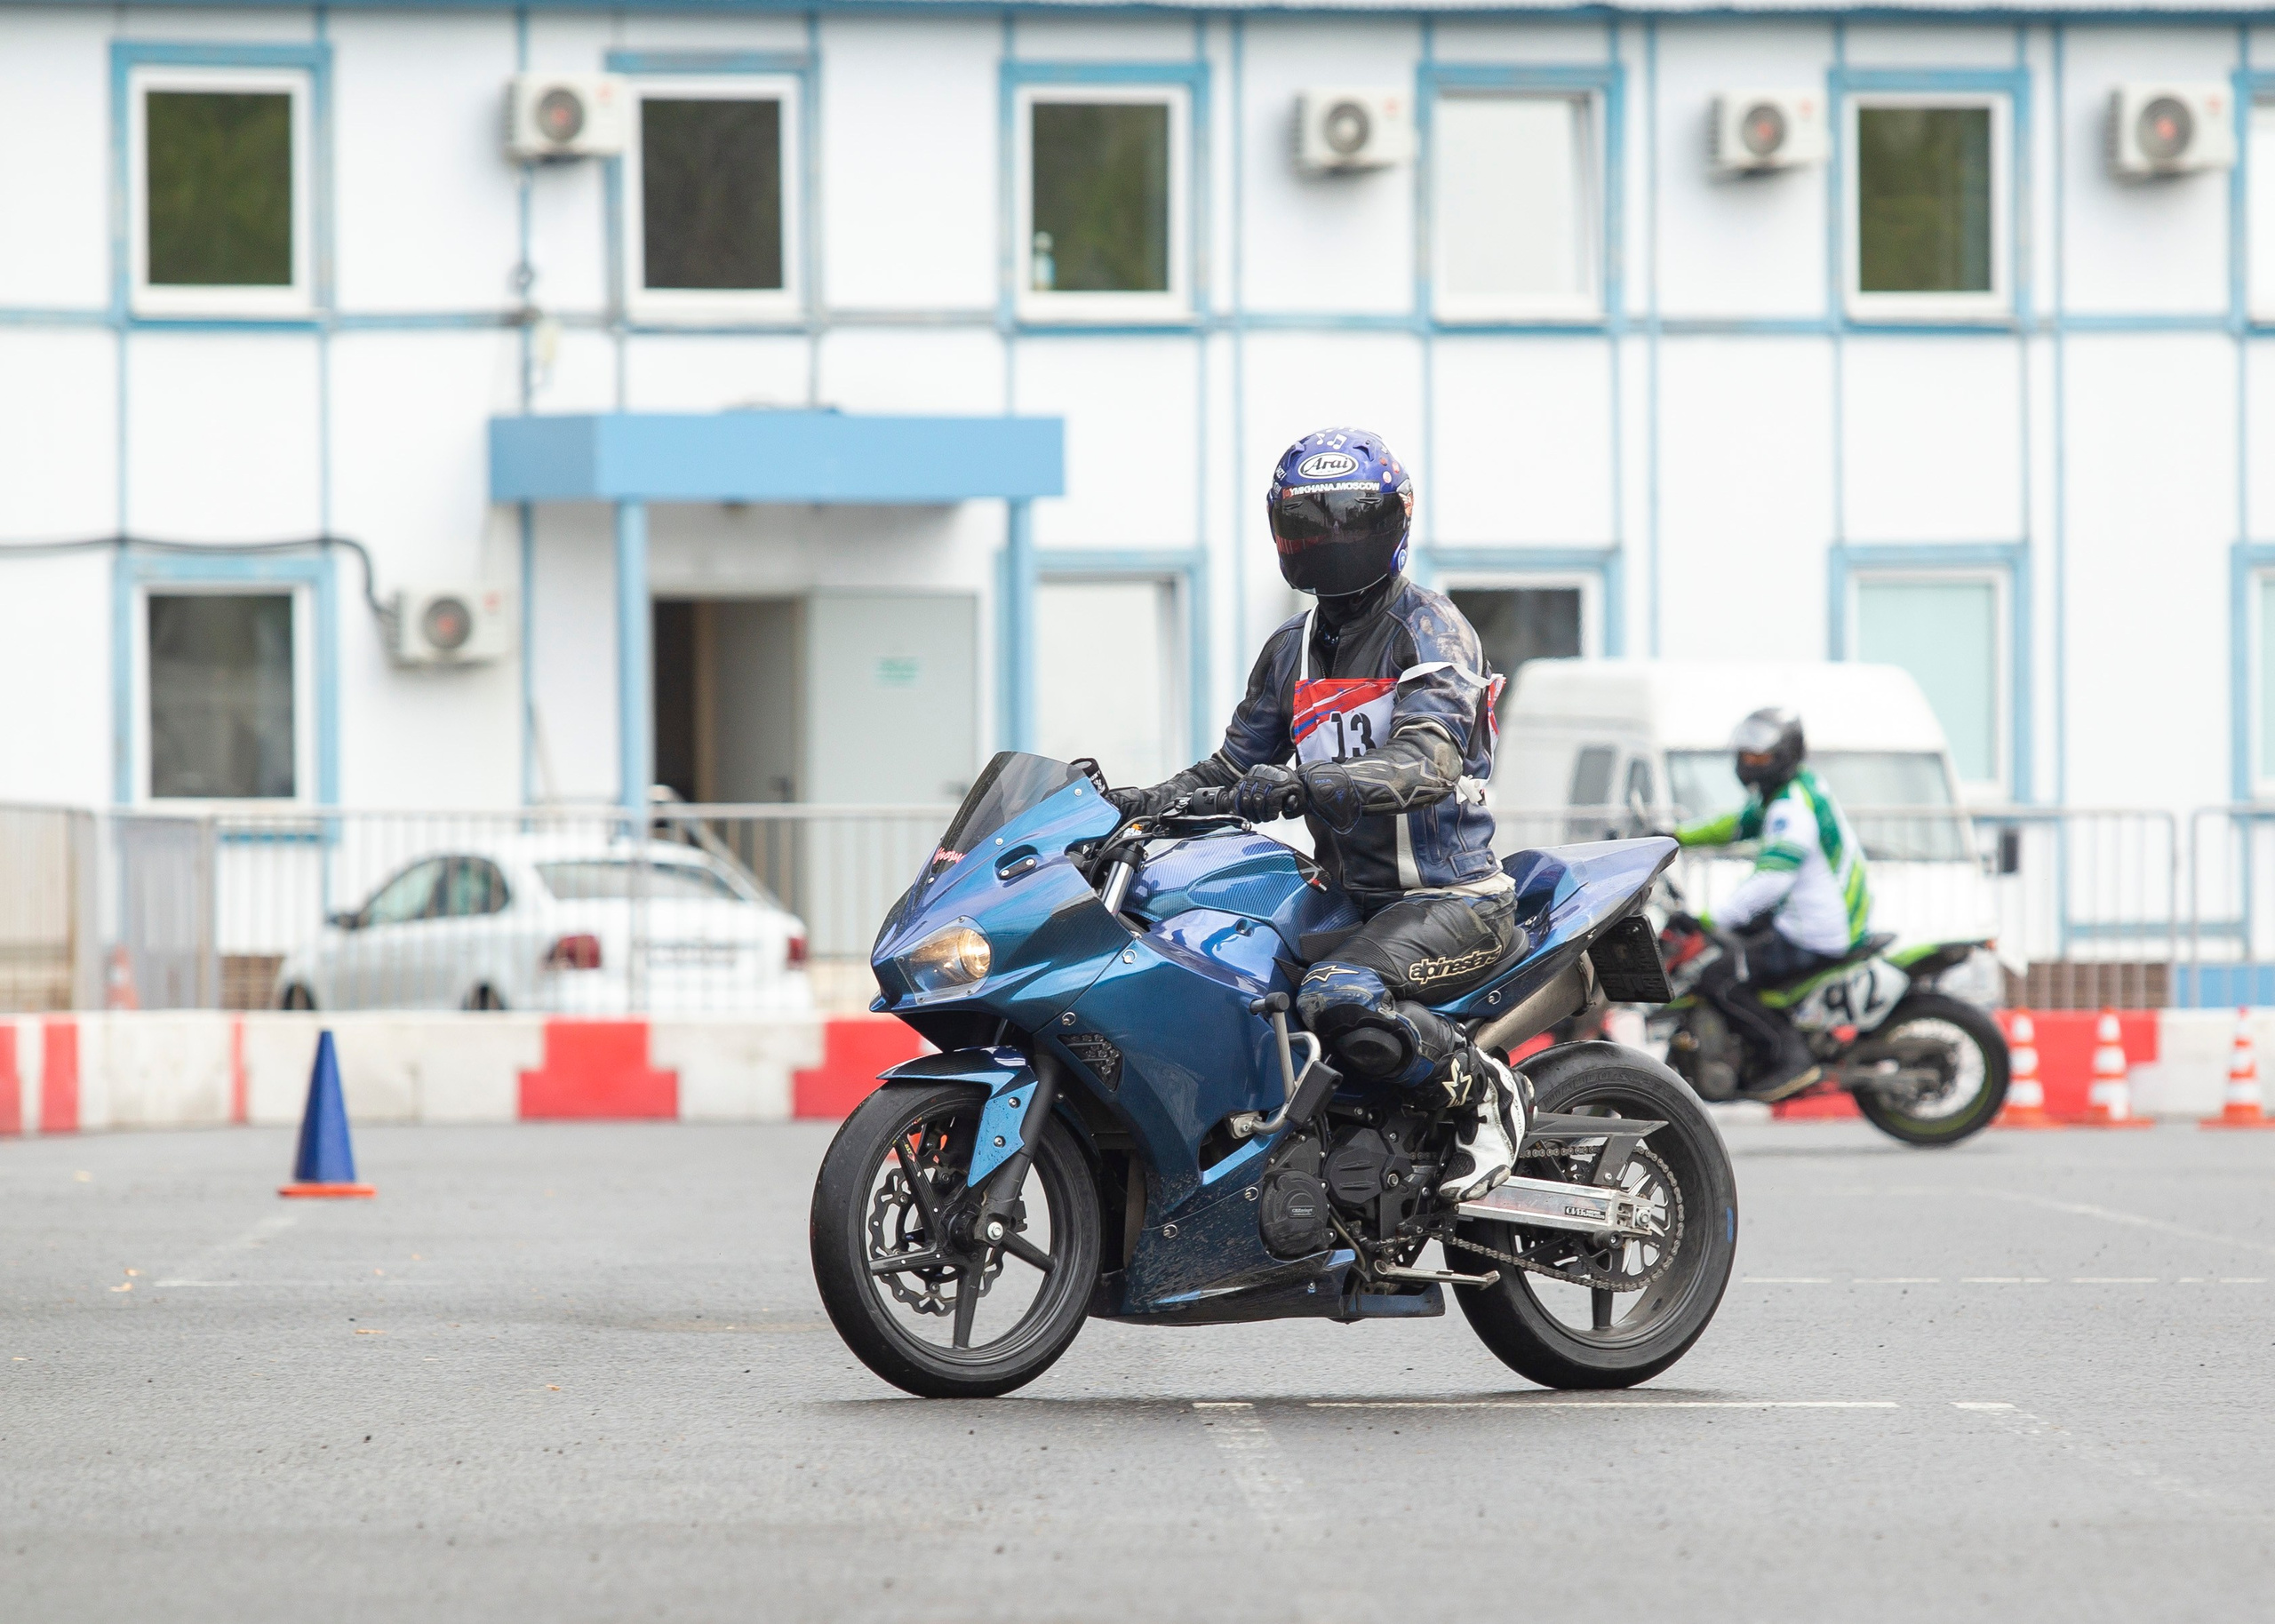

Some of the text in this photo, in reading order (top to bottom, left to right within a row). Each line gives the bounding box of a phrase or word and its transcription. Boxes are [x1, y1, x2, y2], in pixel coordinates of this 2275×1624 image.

[1304, 457, 1349, 474] Arai
[1330, 712, 1377, 764] 13
[1823, 969, 1886, 1023] 92
